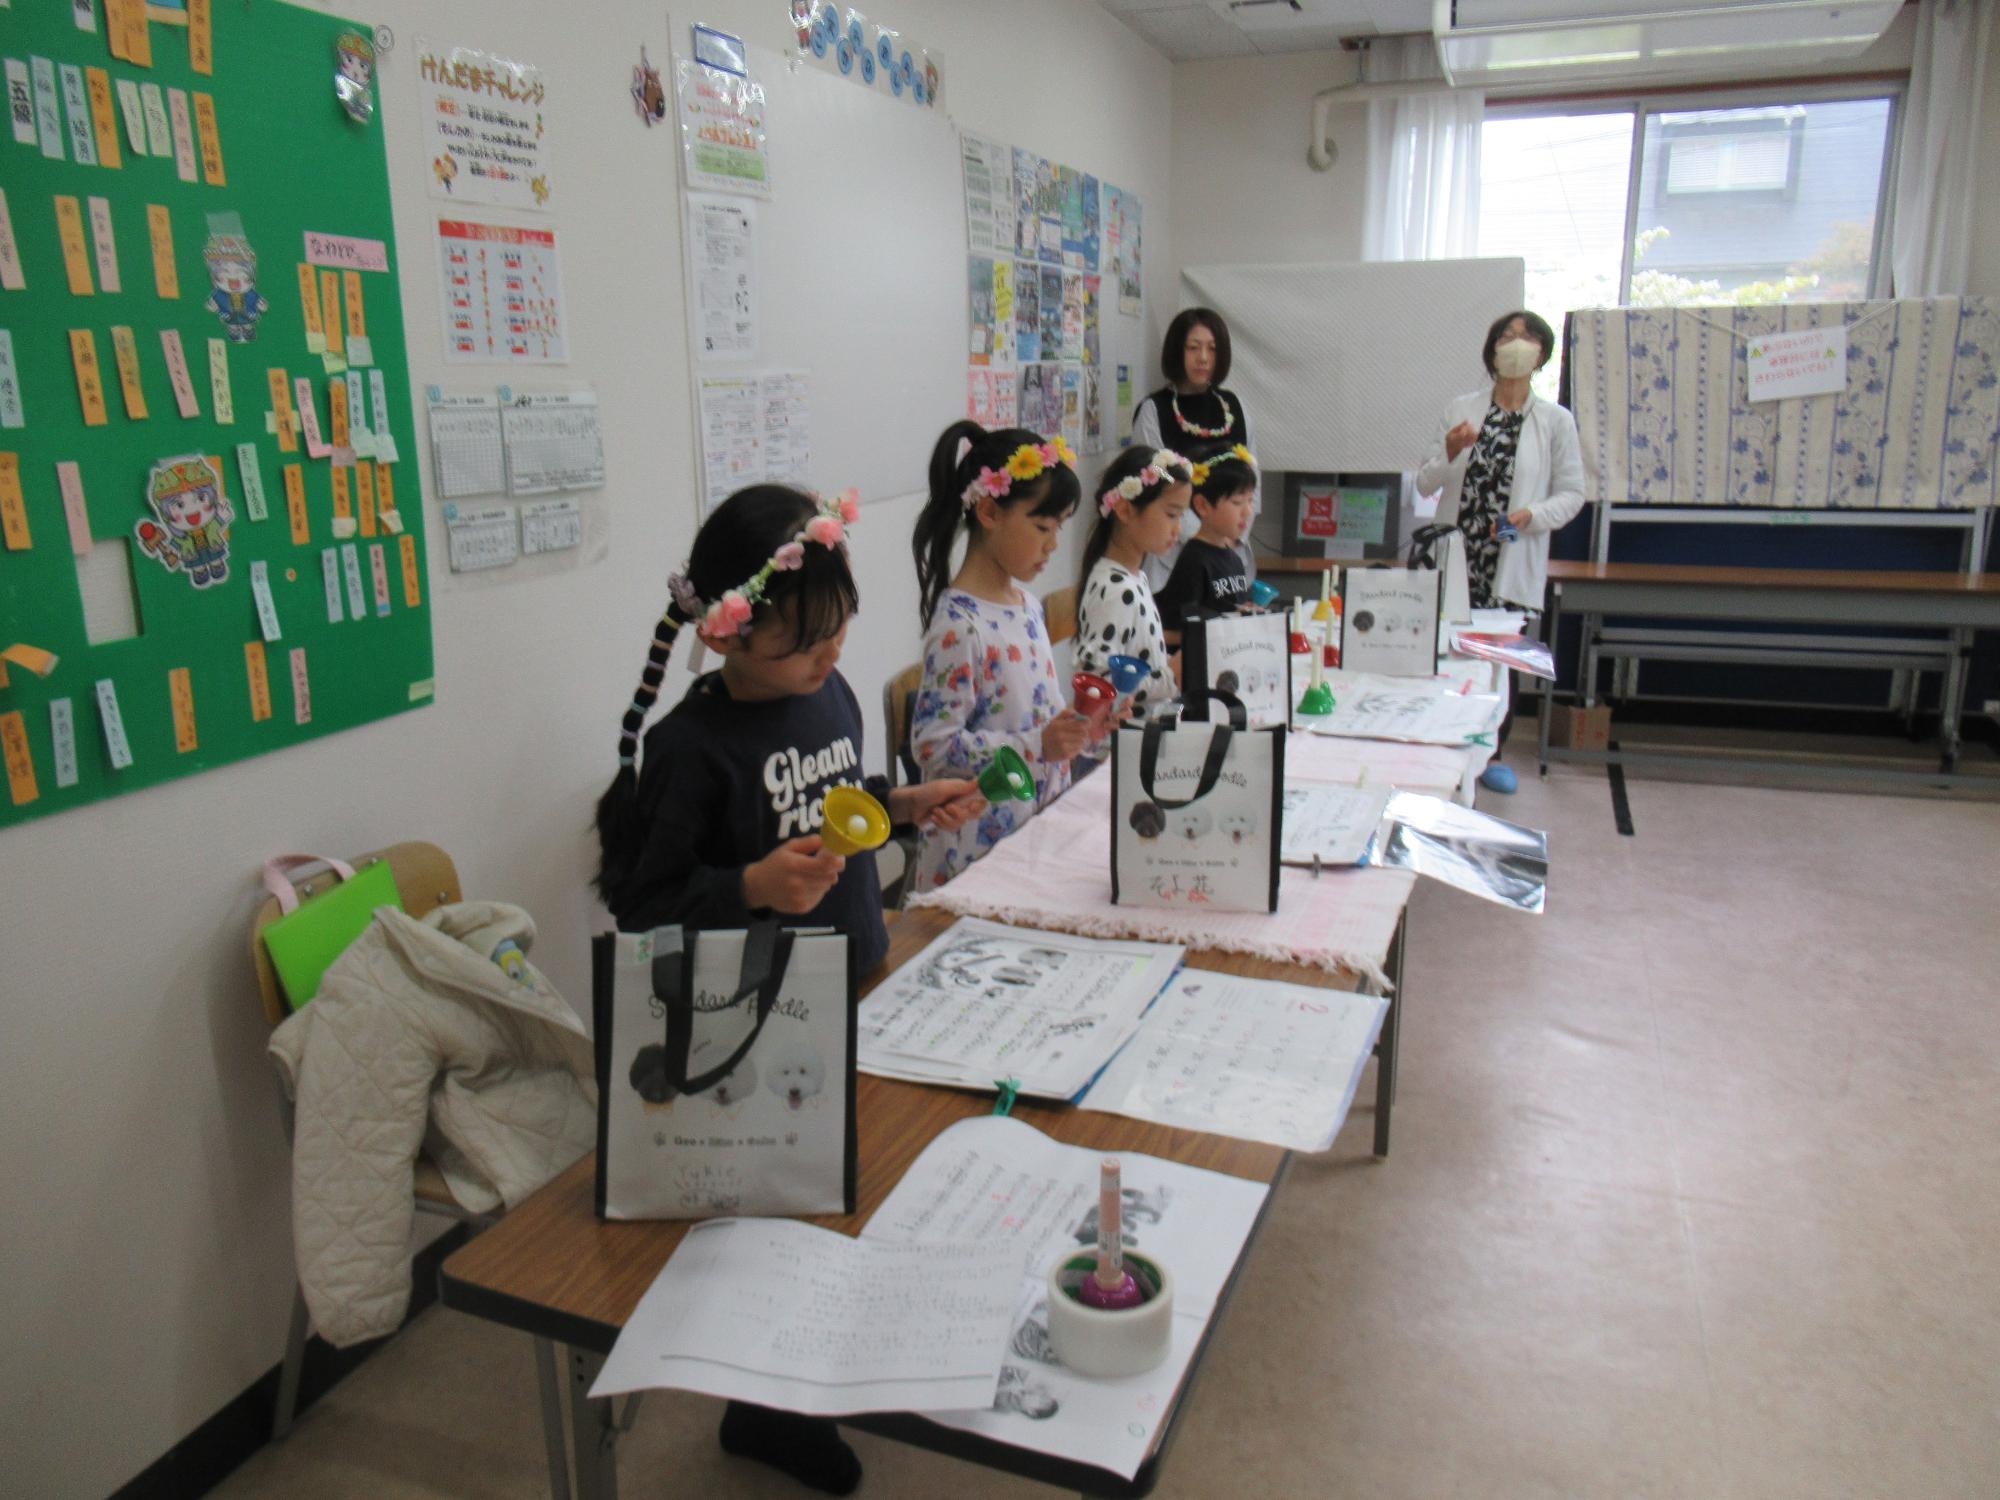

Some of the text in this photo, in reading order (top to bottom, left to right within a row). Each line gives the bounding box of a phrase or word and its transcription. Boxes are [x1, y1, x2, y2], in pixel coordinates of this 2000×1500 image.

[420, 54, 545, 107] けんだまチャレンジ
[763, 736, 858, 812] Gleam
